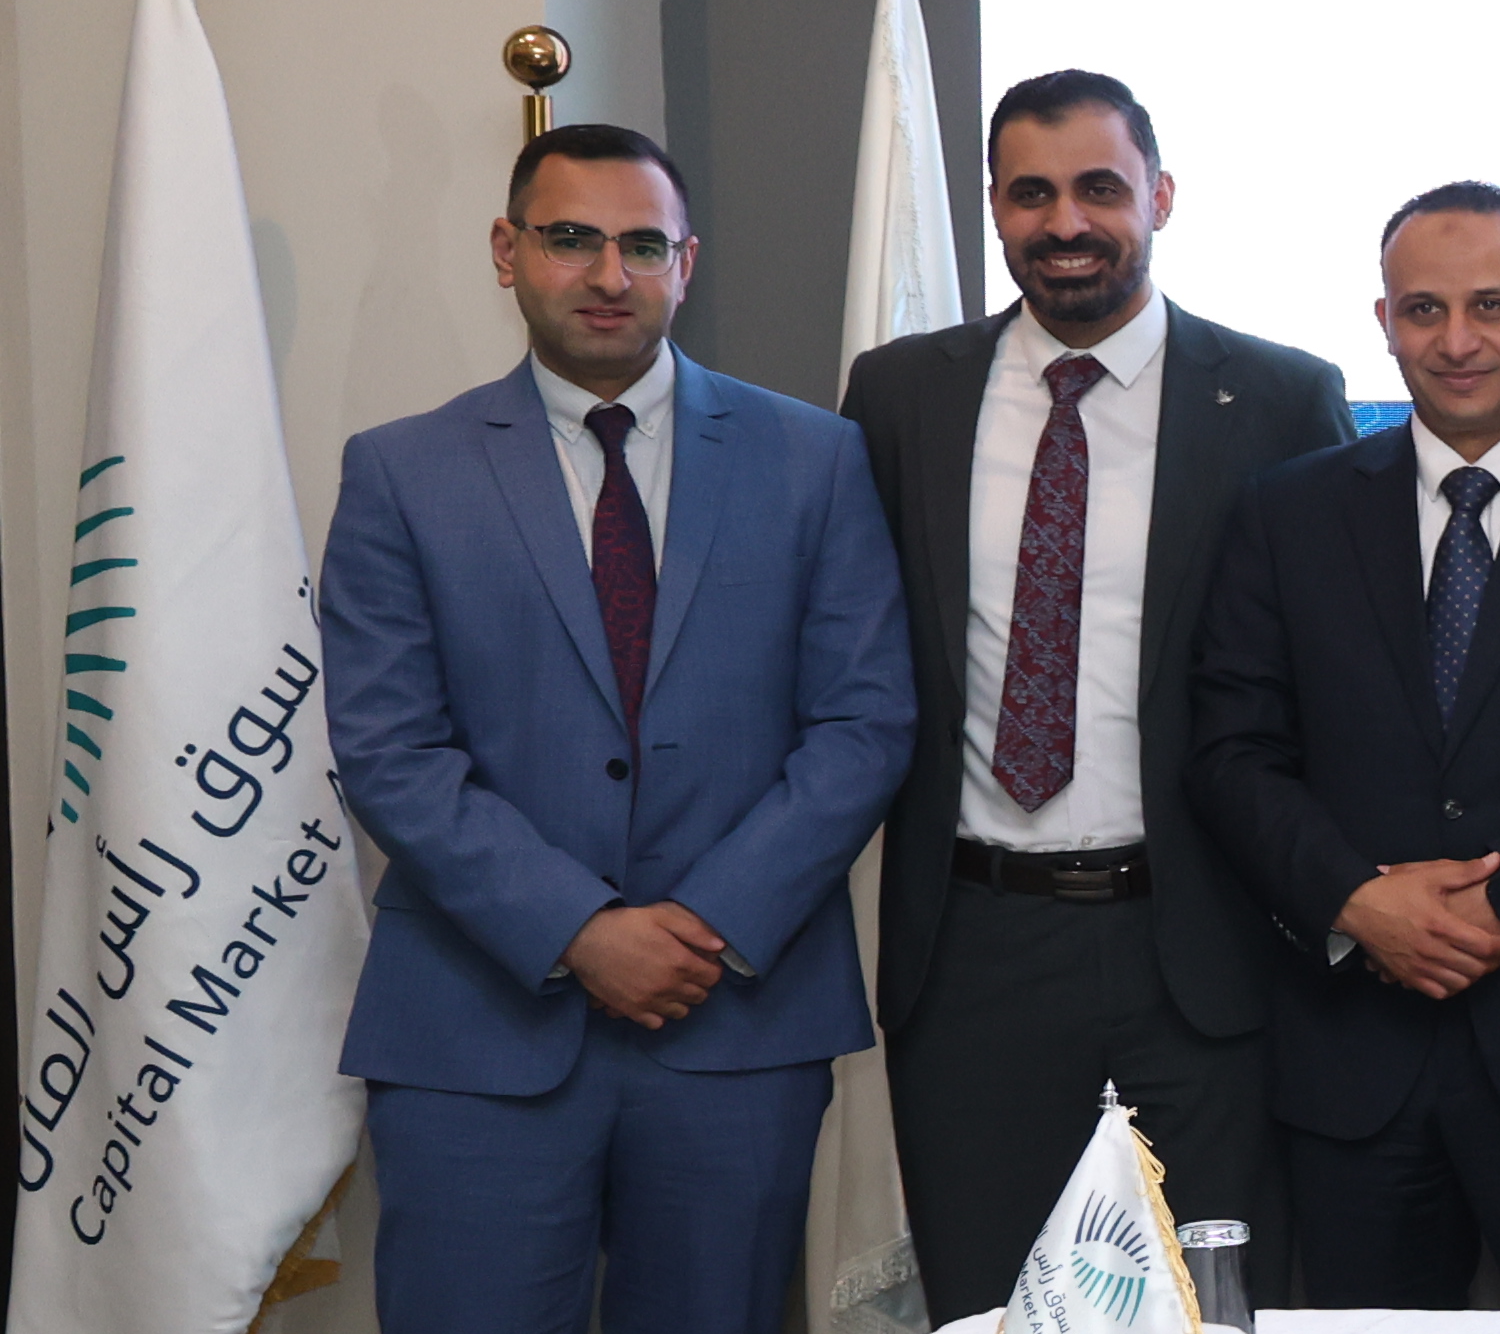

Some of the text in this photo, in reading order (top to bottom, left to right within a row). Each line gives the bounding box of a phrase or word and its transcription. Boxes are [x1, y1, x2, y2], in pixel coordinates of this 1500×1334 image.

[175, 643, 319, 838] سوق
[96, 833, 201, 1000] رأس
[70, 818, 341, 1245] Capital Market
[1033, 1246, 1064, 1285] رأس
[1043, 1289, 1071, 1334] سوق
